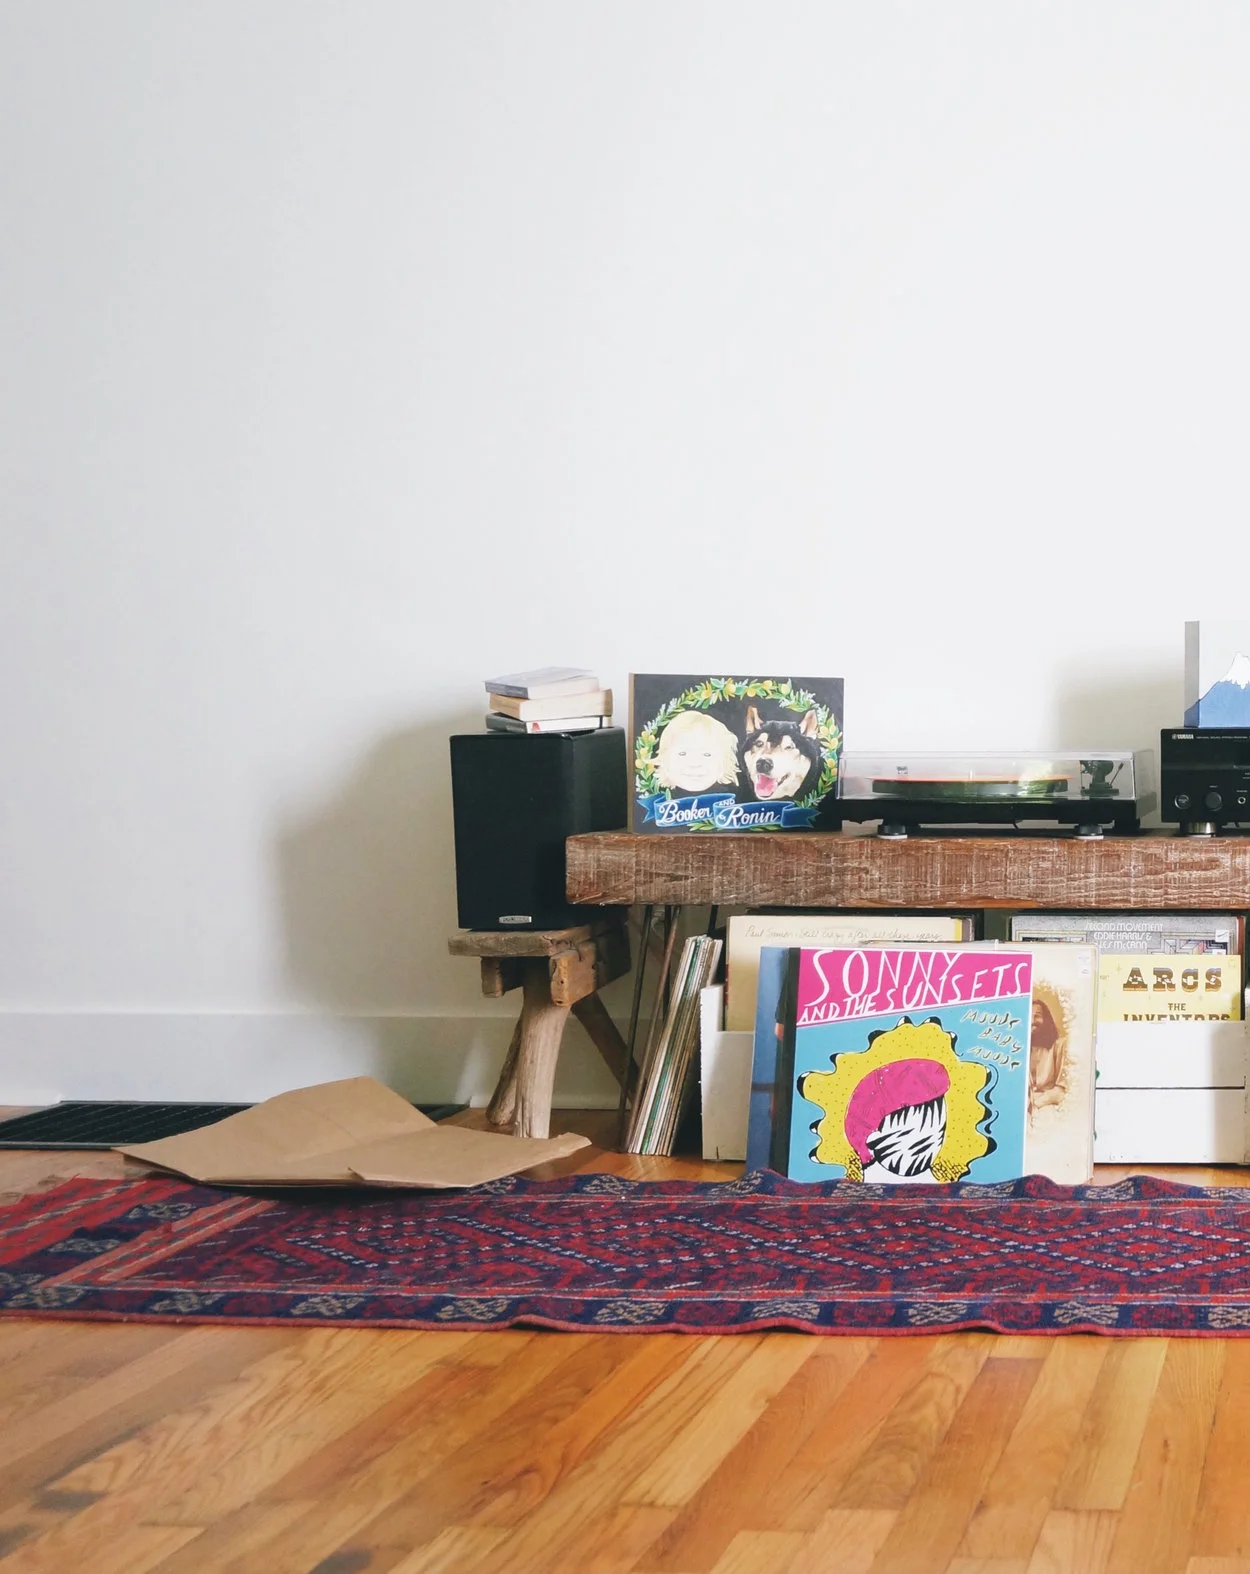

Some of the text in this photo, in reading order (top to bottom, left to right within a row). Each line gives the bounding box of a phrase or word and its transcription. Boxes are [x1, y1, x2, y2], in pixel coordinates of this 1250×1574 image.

[659, 798, 780, 828] Booker AND Ronin
[1093, 931, 1115, 941] EDDIE
[1116, 931, 1145, 941] HARRIS
[804, 949, 965, 1007] SONNY
[1122, 967, 1222, 993] ARCS
[798, 962, 1031, 1024] AND THE SUNSETS
[1167, 1003, 1187, 1011] THE
